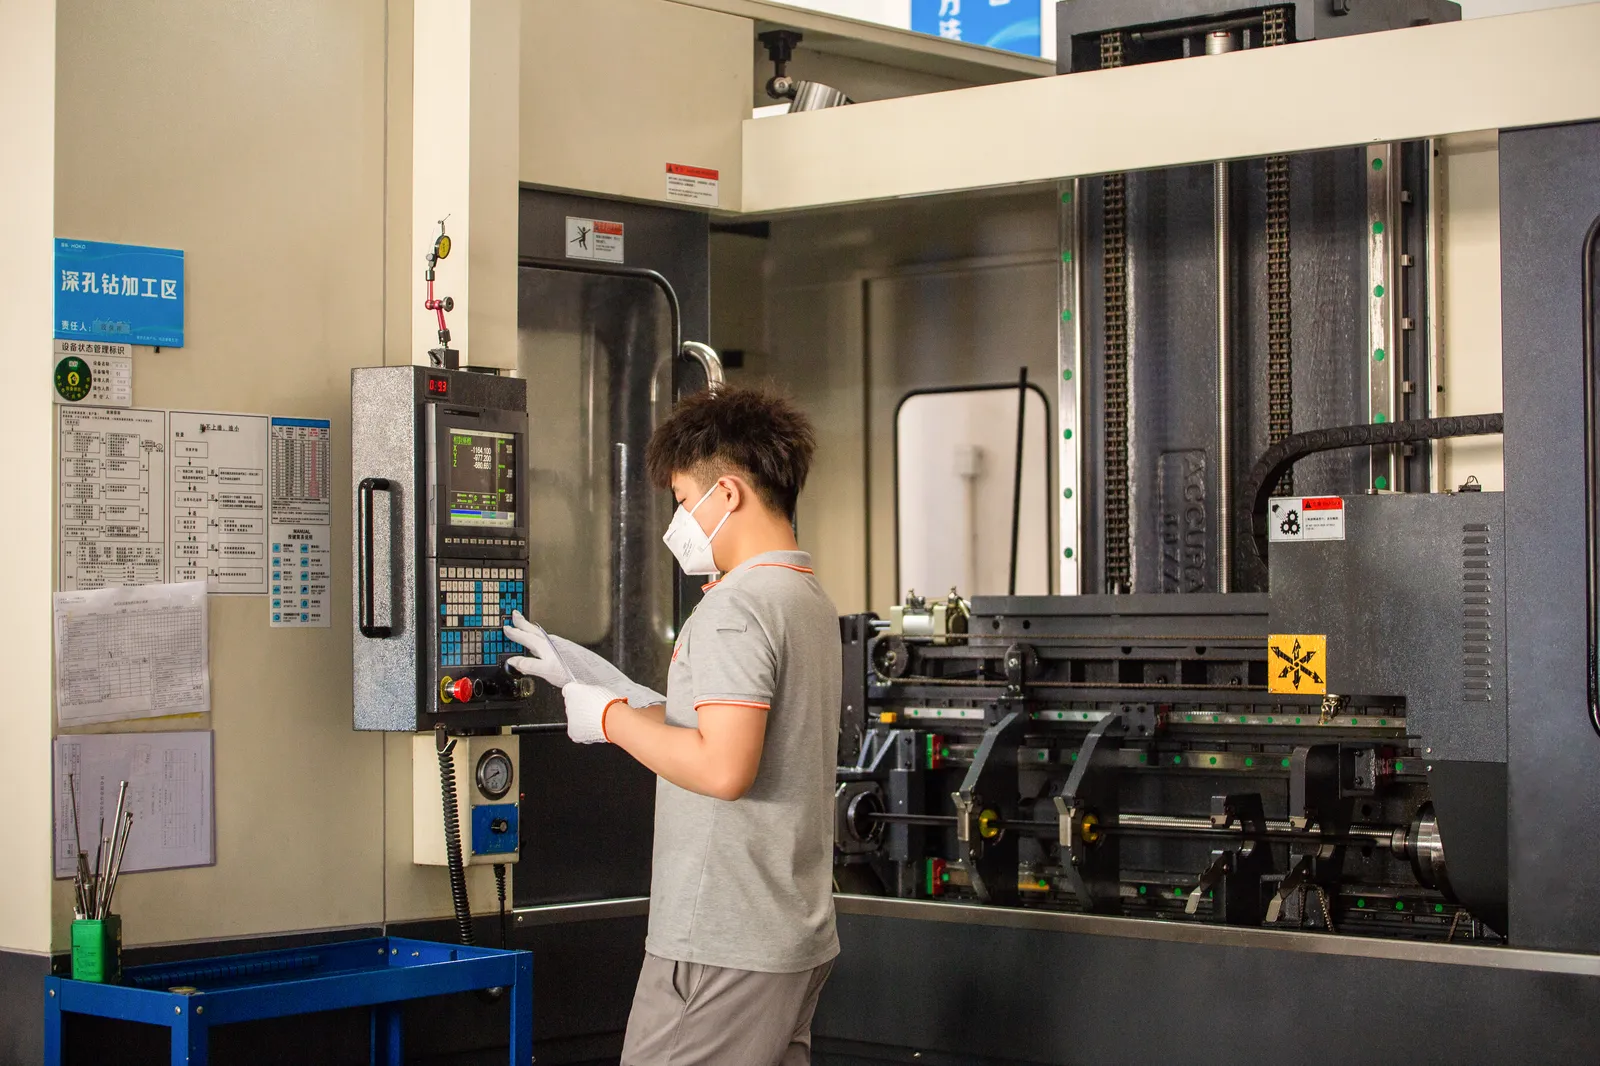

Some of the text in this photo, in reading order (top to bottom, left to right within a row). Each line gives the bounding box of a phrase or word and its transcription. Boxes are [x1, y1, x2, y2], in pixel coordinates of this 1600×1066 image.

[61, 269, 177, 300] 深孔钻加工区
[62, 342, 125, 355] 设备状态管理标识
